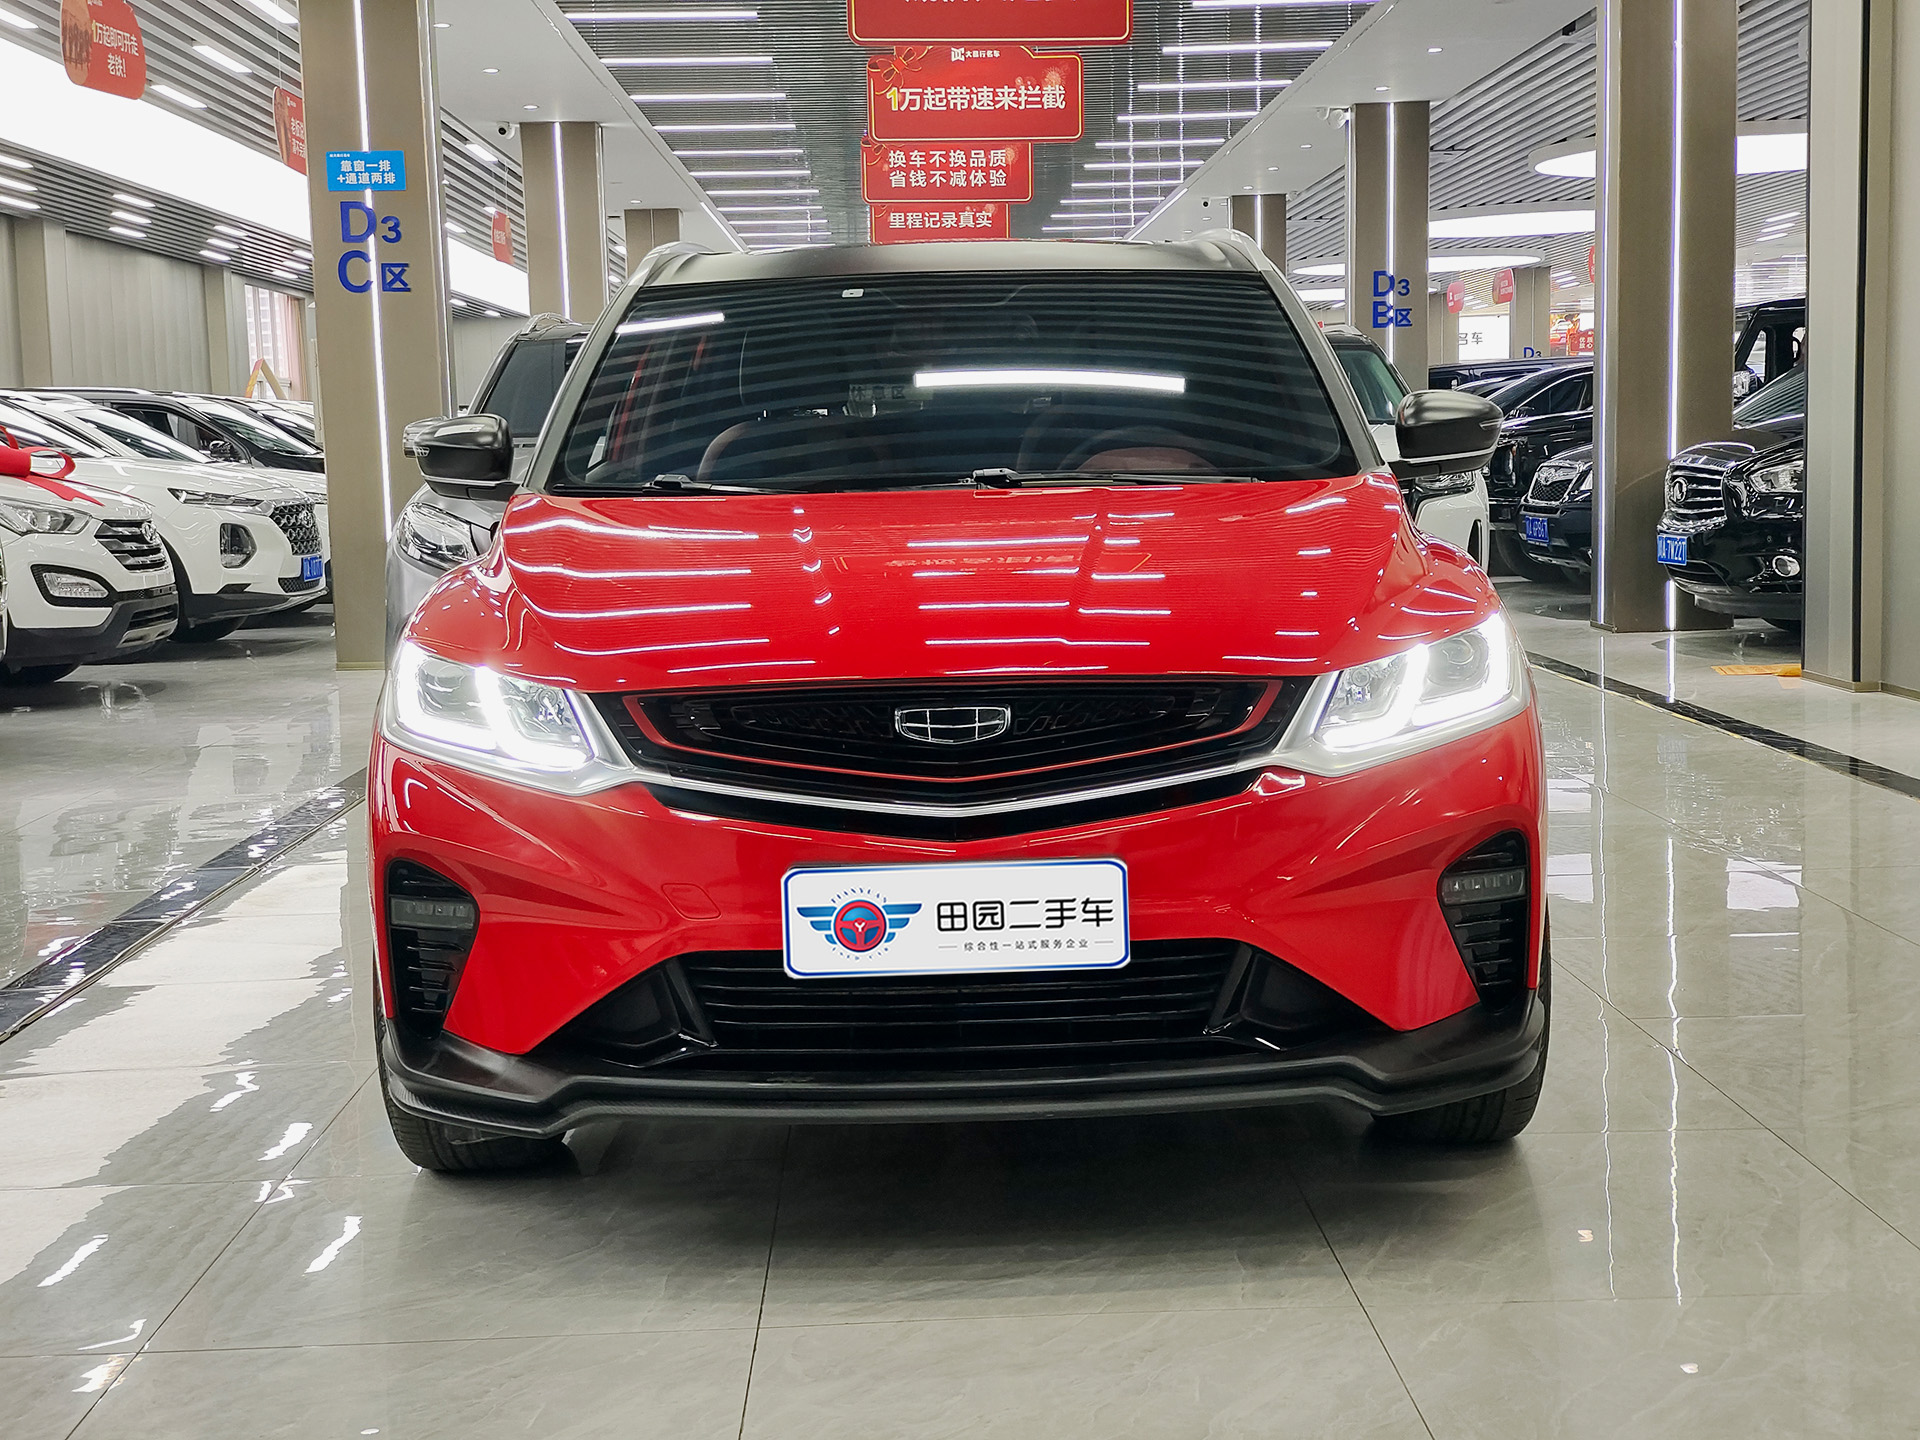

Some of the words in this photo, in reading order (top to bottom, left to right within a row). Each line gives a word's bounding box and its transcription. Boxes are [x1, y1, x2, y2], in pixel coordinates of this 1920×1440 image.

[886, 85, 1066, 112] 1万起带速来拦截
[340, 160, 391, 172] 靠窗一排
[888, 150, 1007, 168] 换车不换品质
[337, 172, 396, 184] +通道两排
[889, 169, 1007, 188] 省钱不减体验
[889, 210, 992, 229] 里程记录真实
[937, 897, 1114, 932] 田园二手车
[964, 938, 1089, 951] 综合性一站式服务企业
